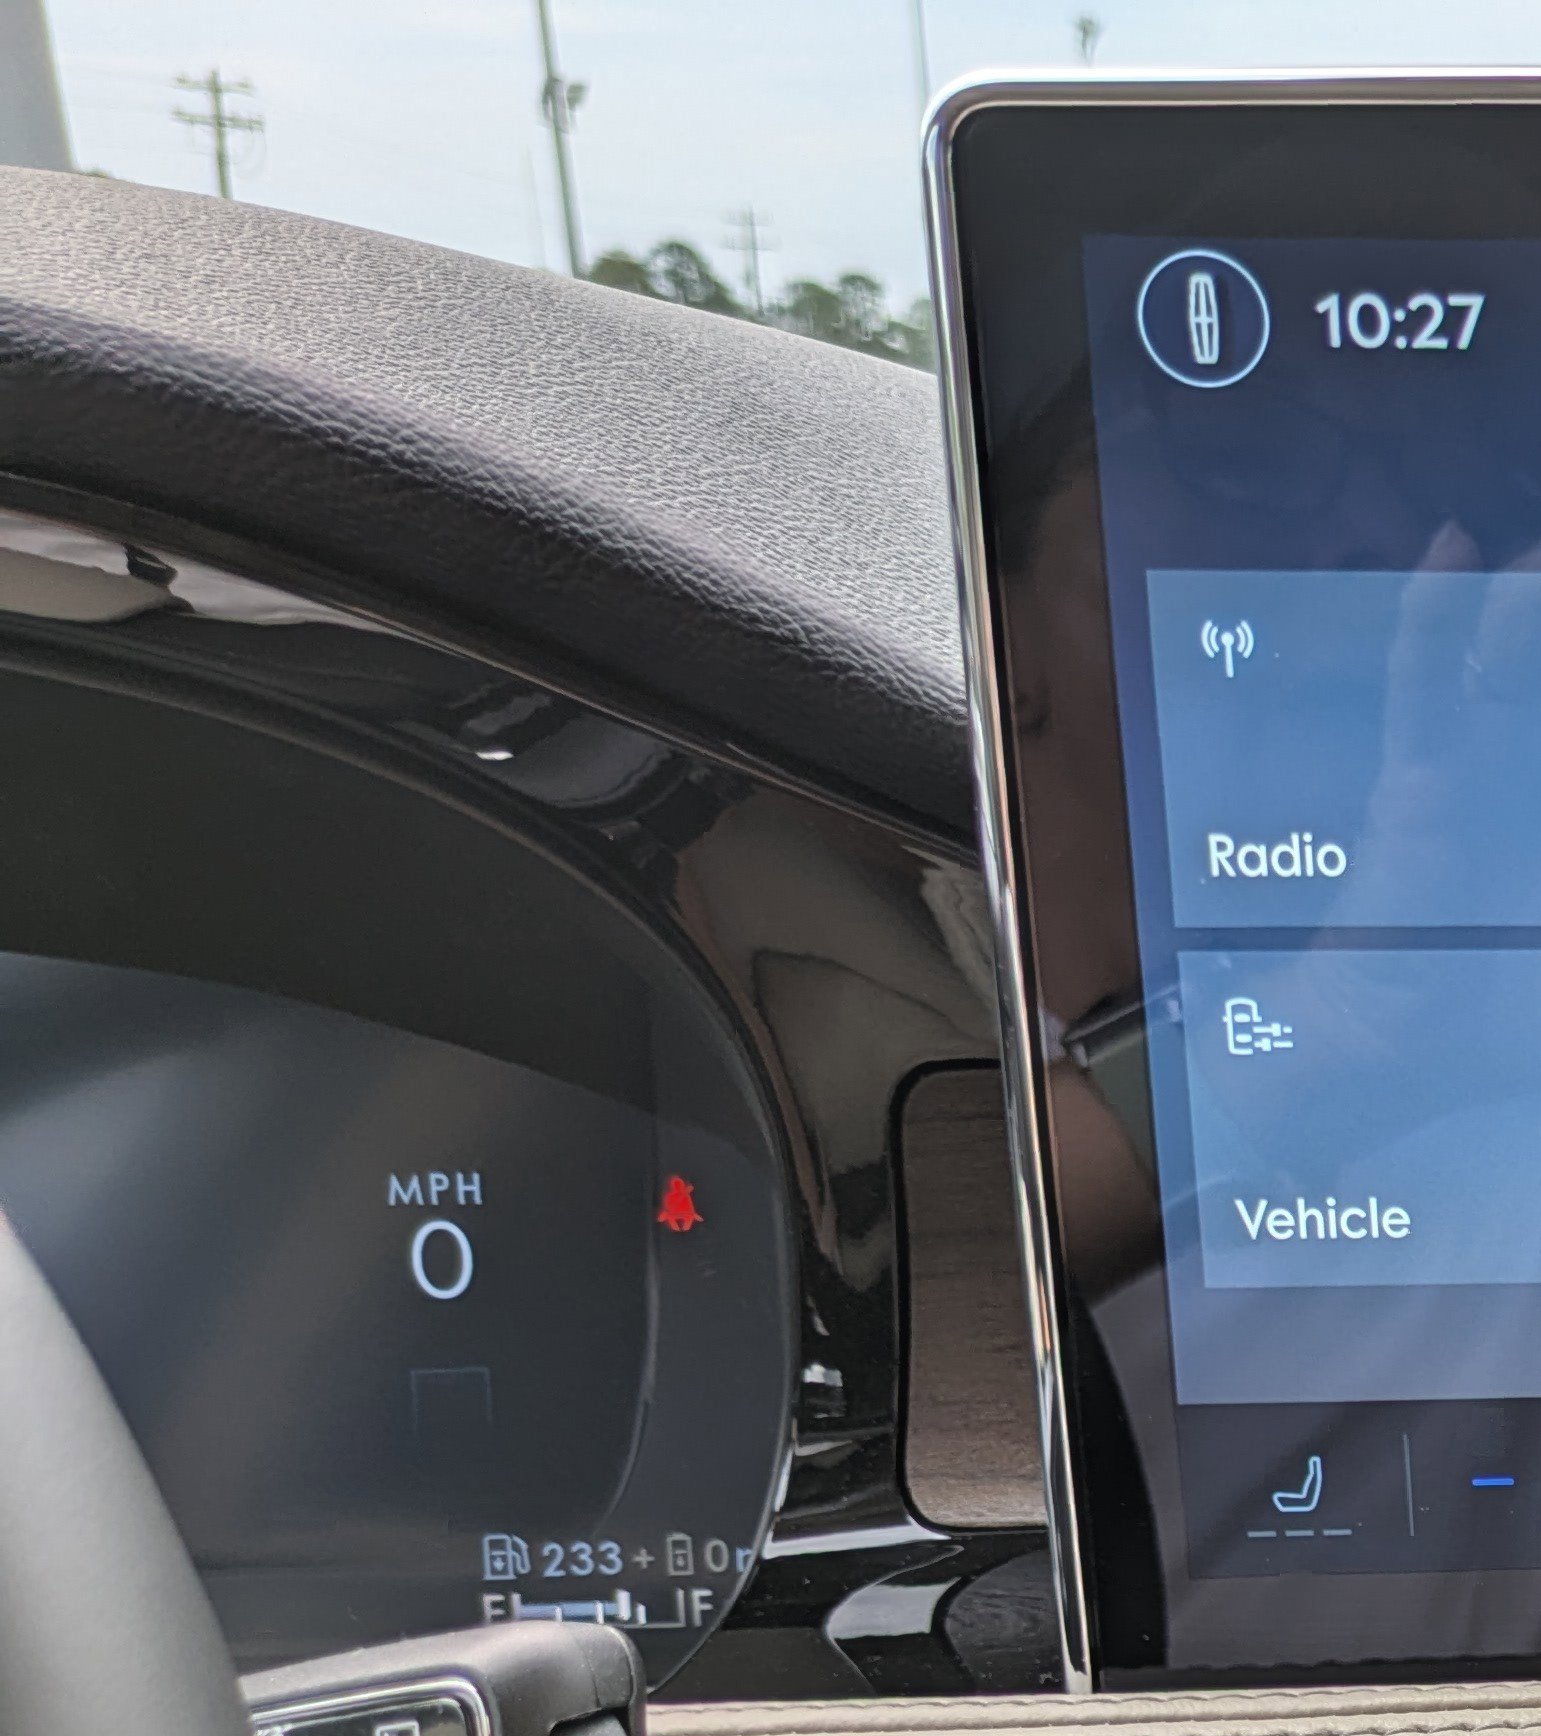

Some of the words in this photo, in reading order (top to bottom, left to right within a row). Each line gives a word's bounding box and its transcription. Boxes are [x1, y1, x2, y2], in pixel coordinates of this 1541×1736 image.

[1314, 291, 1486, 351] 10:27
[1207, 830, 1348, 879] Radio
[387, 1171, 484, 1207] MPH
[1233, 1195, 1412, 1241] Vehicle
[410, 1219, 474, 1301] 0
[541, 1540, 624, 1578] 233
[690, 1587, 714, 1626] F
